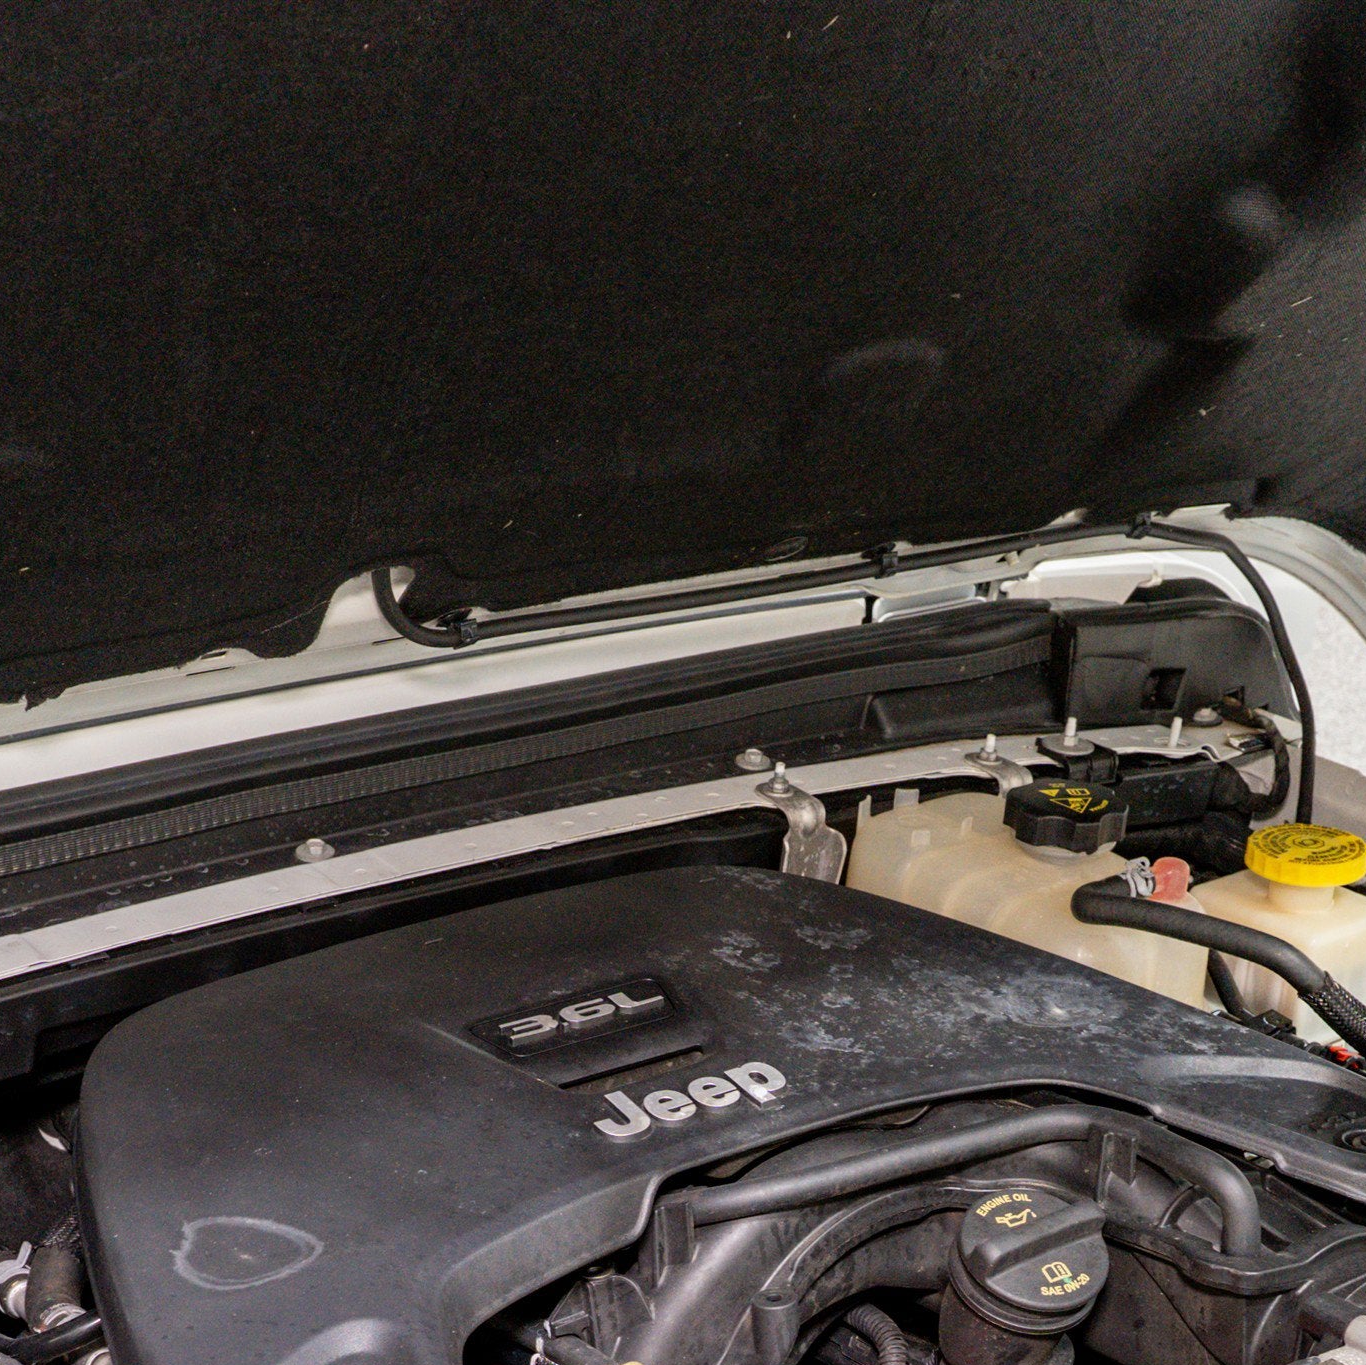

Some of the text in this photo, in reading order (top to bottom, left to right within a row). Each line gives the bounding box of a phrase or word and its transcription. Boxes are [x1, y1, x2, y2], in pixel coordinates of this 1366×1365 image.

[498, 991, 664, 1048] 3.6L
[593, 1061, 787, 1141] Jeep
[976, 1193, 1032, 1217] ENGINE OIL
[1040, 1286, 1065, 1296] SAE
